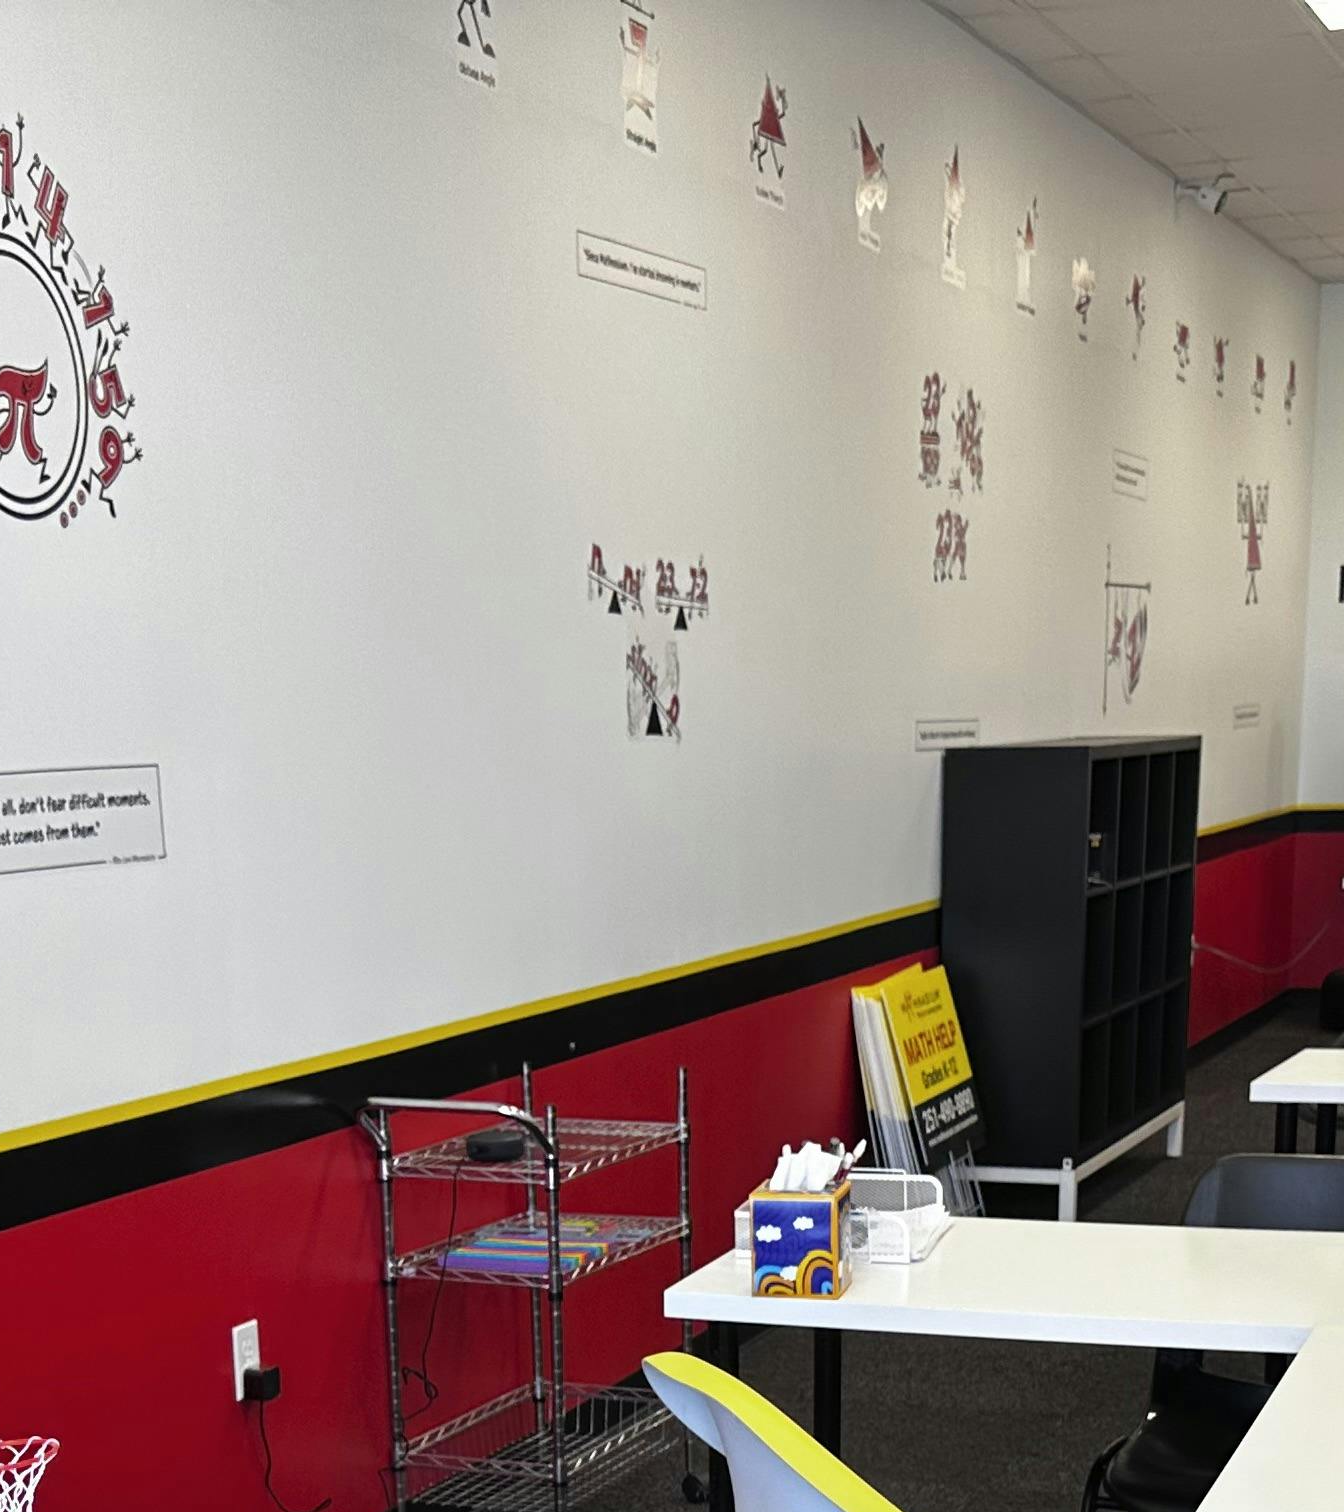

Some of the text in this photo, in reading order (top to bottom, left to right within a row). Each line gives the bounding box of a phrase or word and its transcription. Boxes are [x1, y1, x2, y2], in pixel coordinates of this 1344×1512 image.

[19, 797, 45, 815] don't
[47, 795, 67, 813] fear
[69, 792, 106, 811] difficult
[13, 829, 45, 845] comes
[46, 825, 69, 841] from
[903, 1018, 956, 1067] MATH HELP
